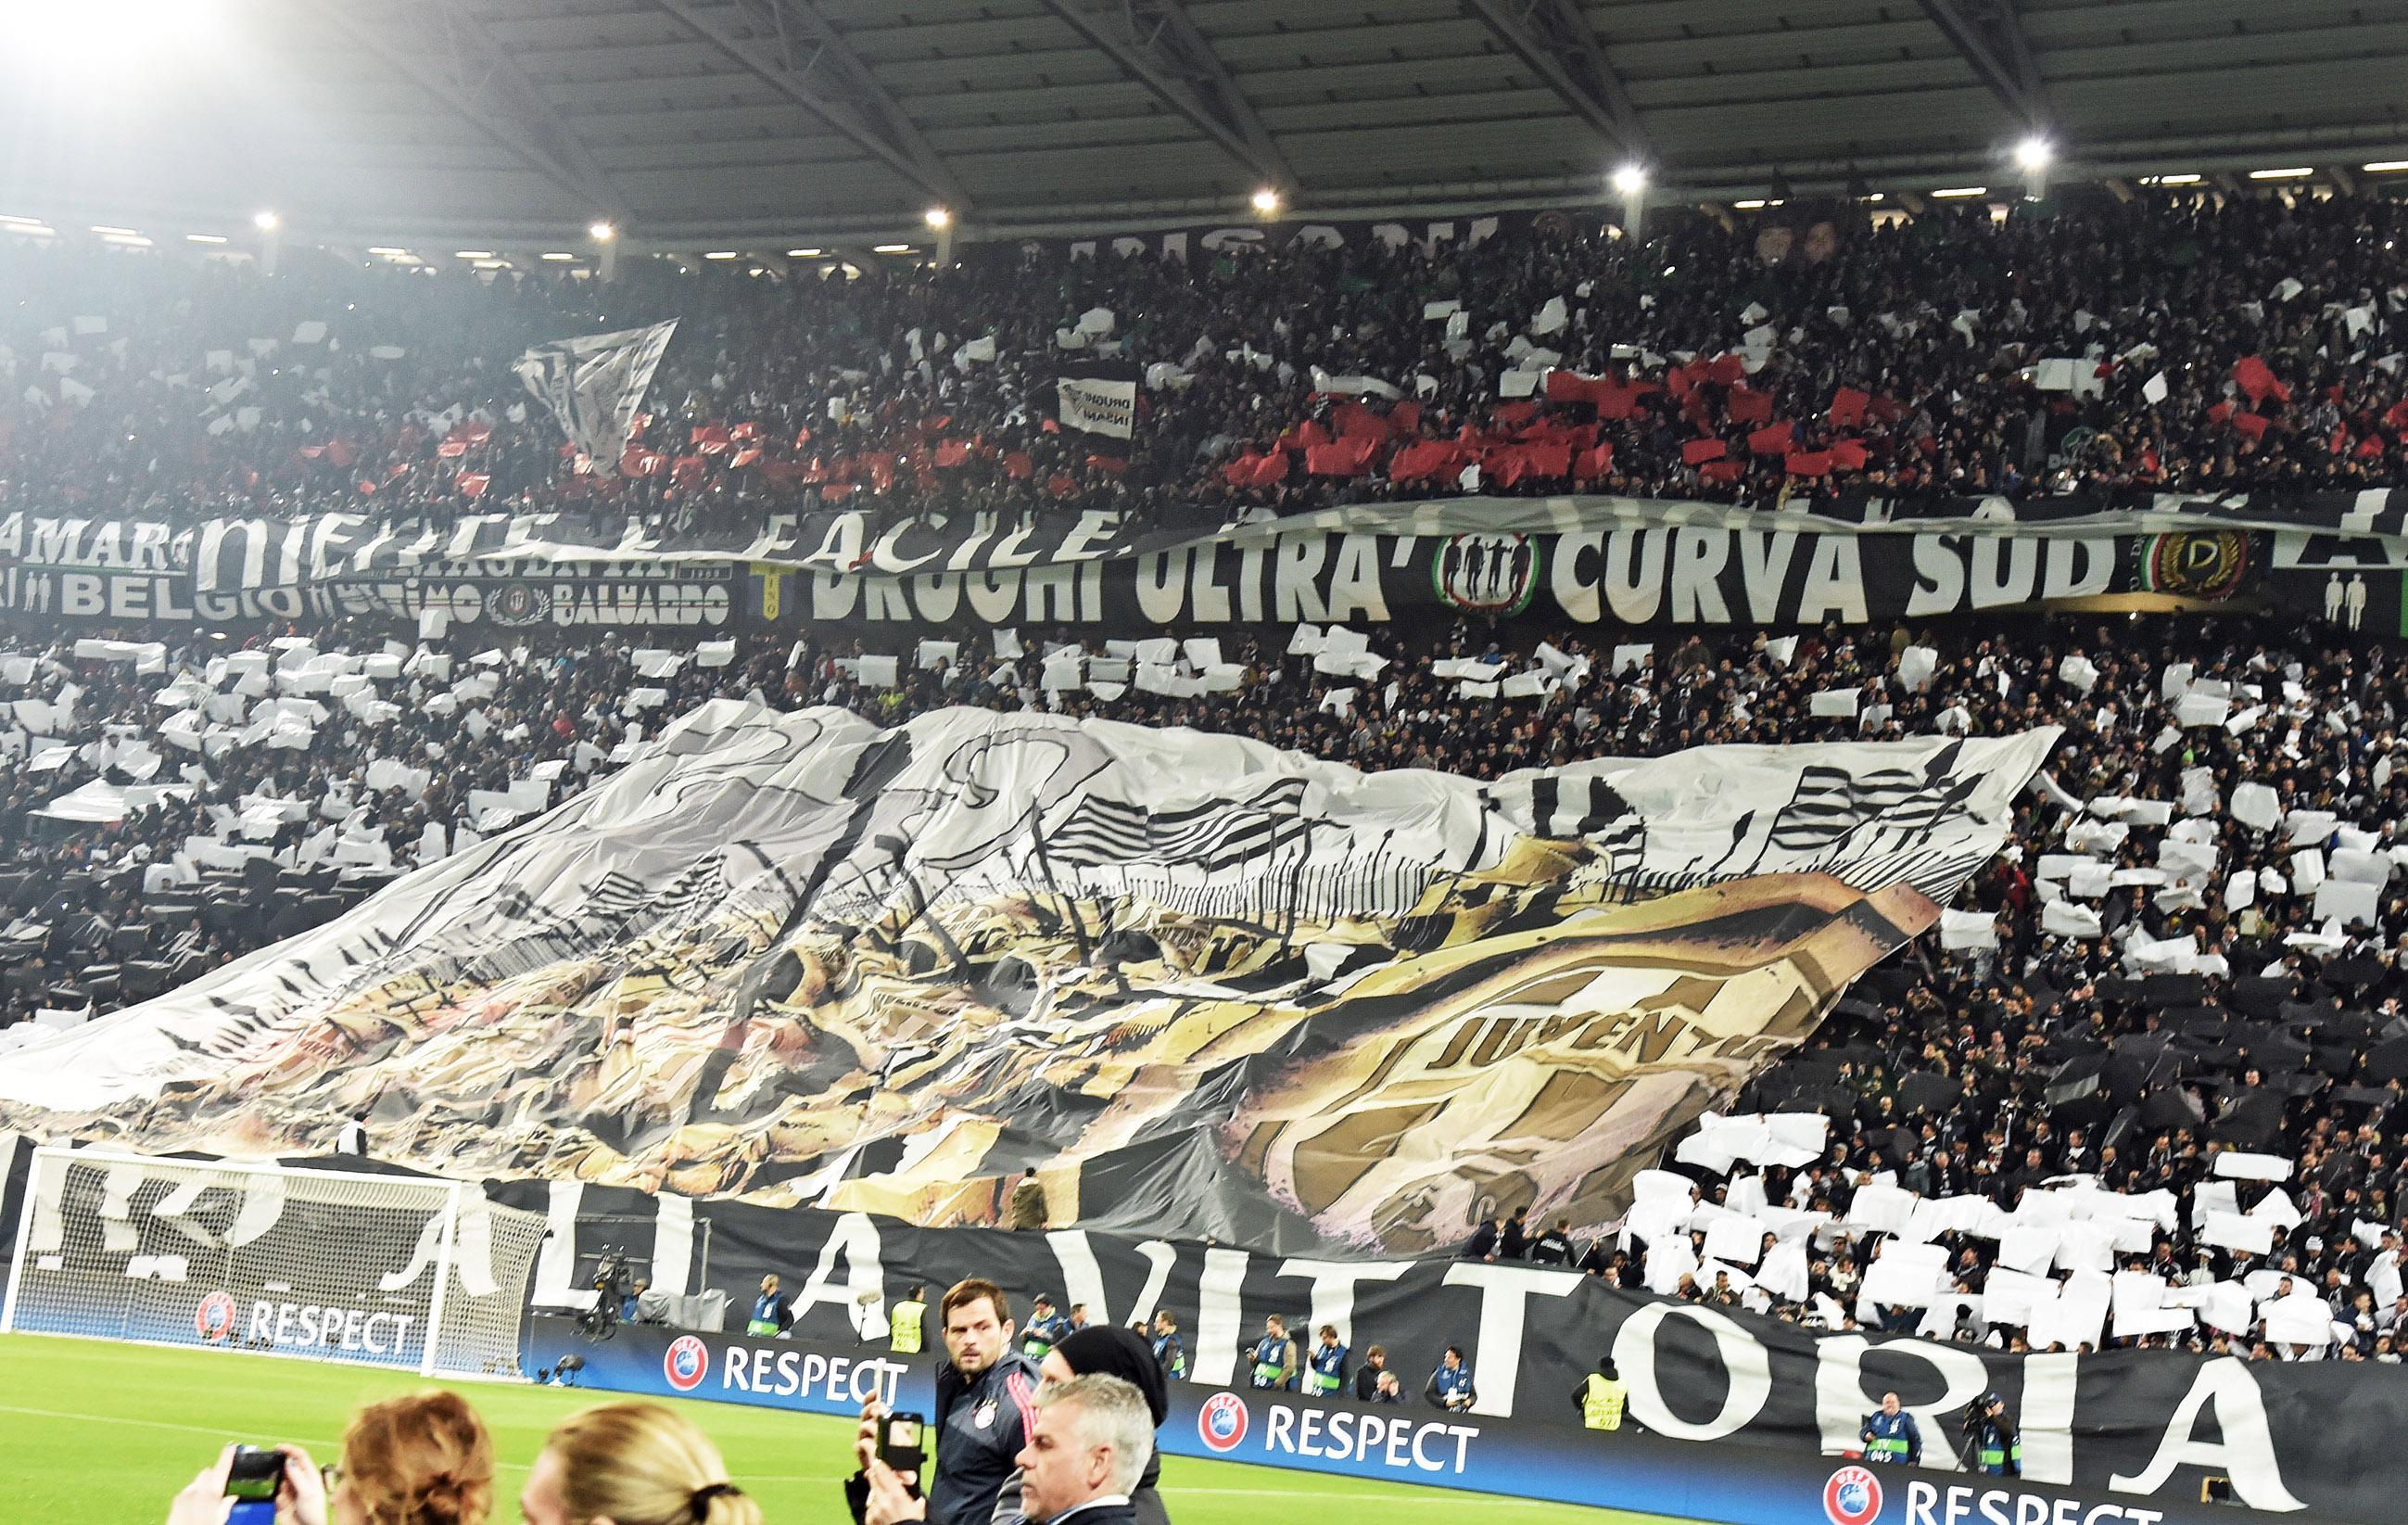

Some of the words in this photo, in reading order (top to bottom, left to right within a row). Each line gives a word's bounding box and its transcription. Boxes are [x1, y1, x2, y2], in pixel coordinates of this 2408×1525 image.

[552, 584, 729, 628] BALUARDO
[1552, 527, 1869, 623] CURVA
[1906, 531, 2117, 616] SUD
[248, 1300, 415, 1355] RESPECT
[723, 1346, 909, 1407] RESPECT
[1045, 1229, 2310, 1512] VITTORIA
[1265, 1404, 1480, 1474] RESPECT
